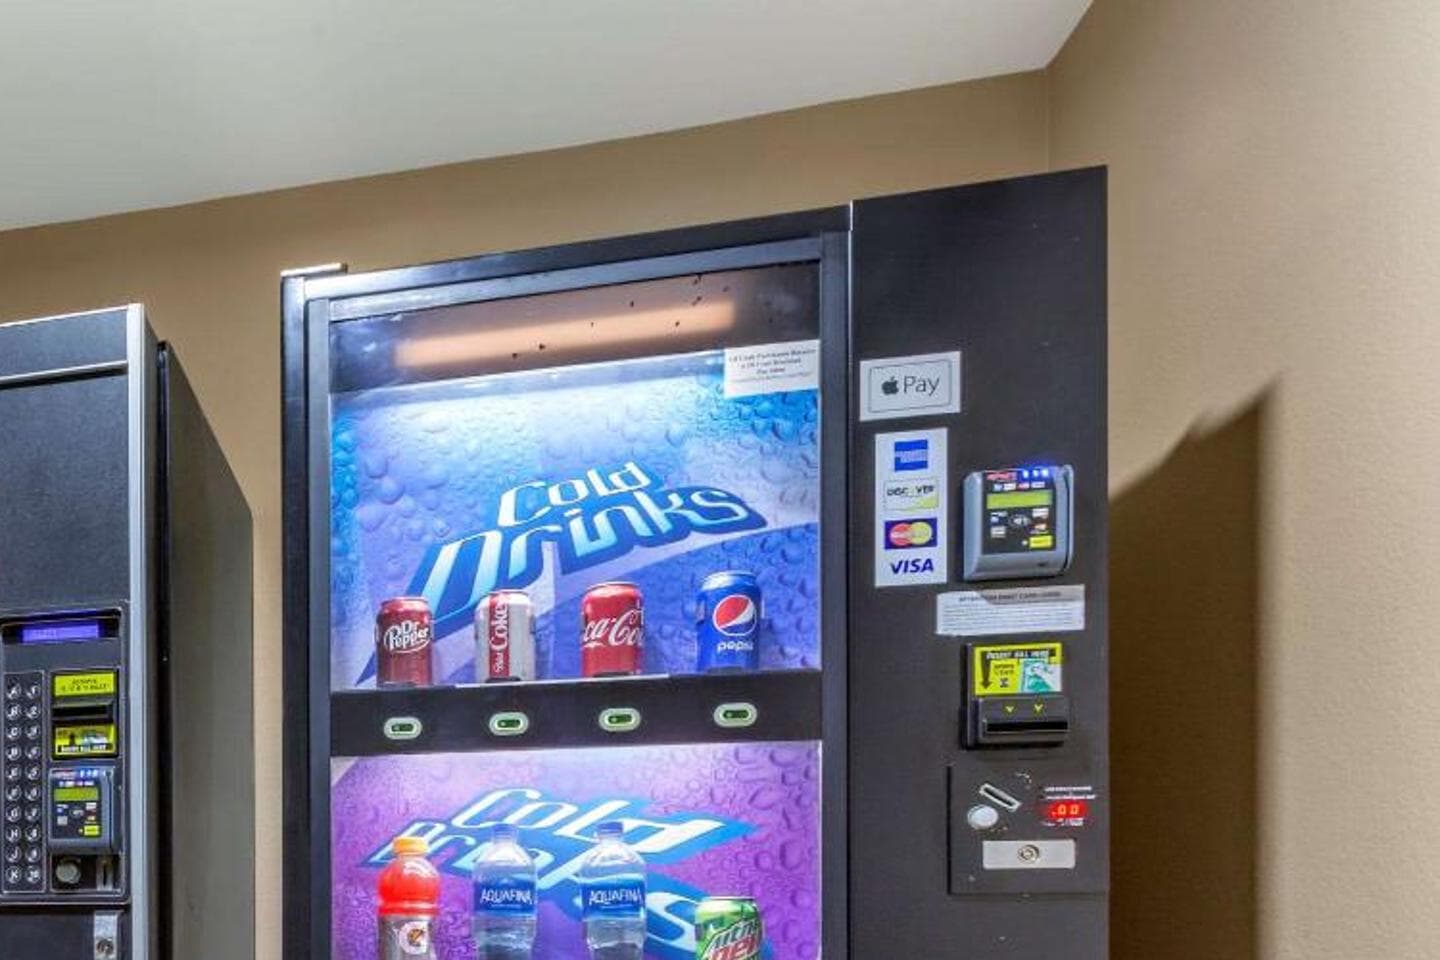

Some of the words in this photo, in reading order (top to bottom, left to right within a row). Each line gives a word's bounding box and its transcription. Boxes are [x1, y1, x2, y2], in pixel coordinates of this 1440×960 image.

[903, 375, 940, 396] Pay
[497, 462, 651, 527] Cold
[423, 489, 750, 622] Drinks
[890, 558, 935, 575] VISA
[385, 625, 430, 650] Pepper
[401, 620, 419, 633] Dr
[489, 603, 508, 650] Coke
